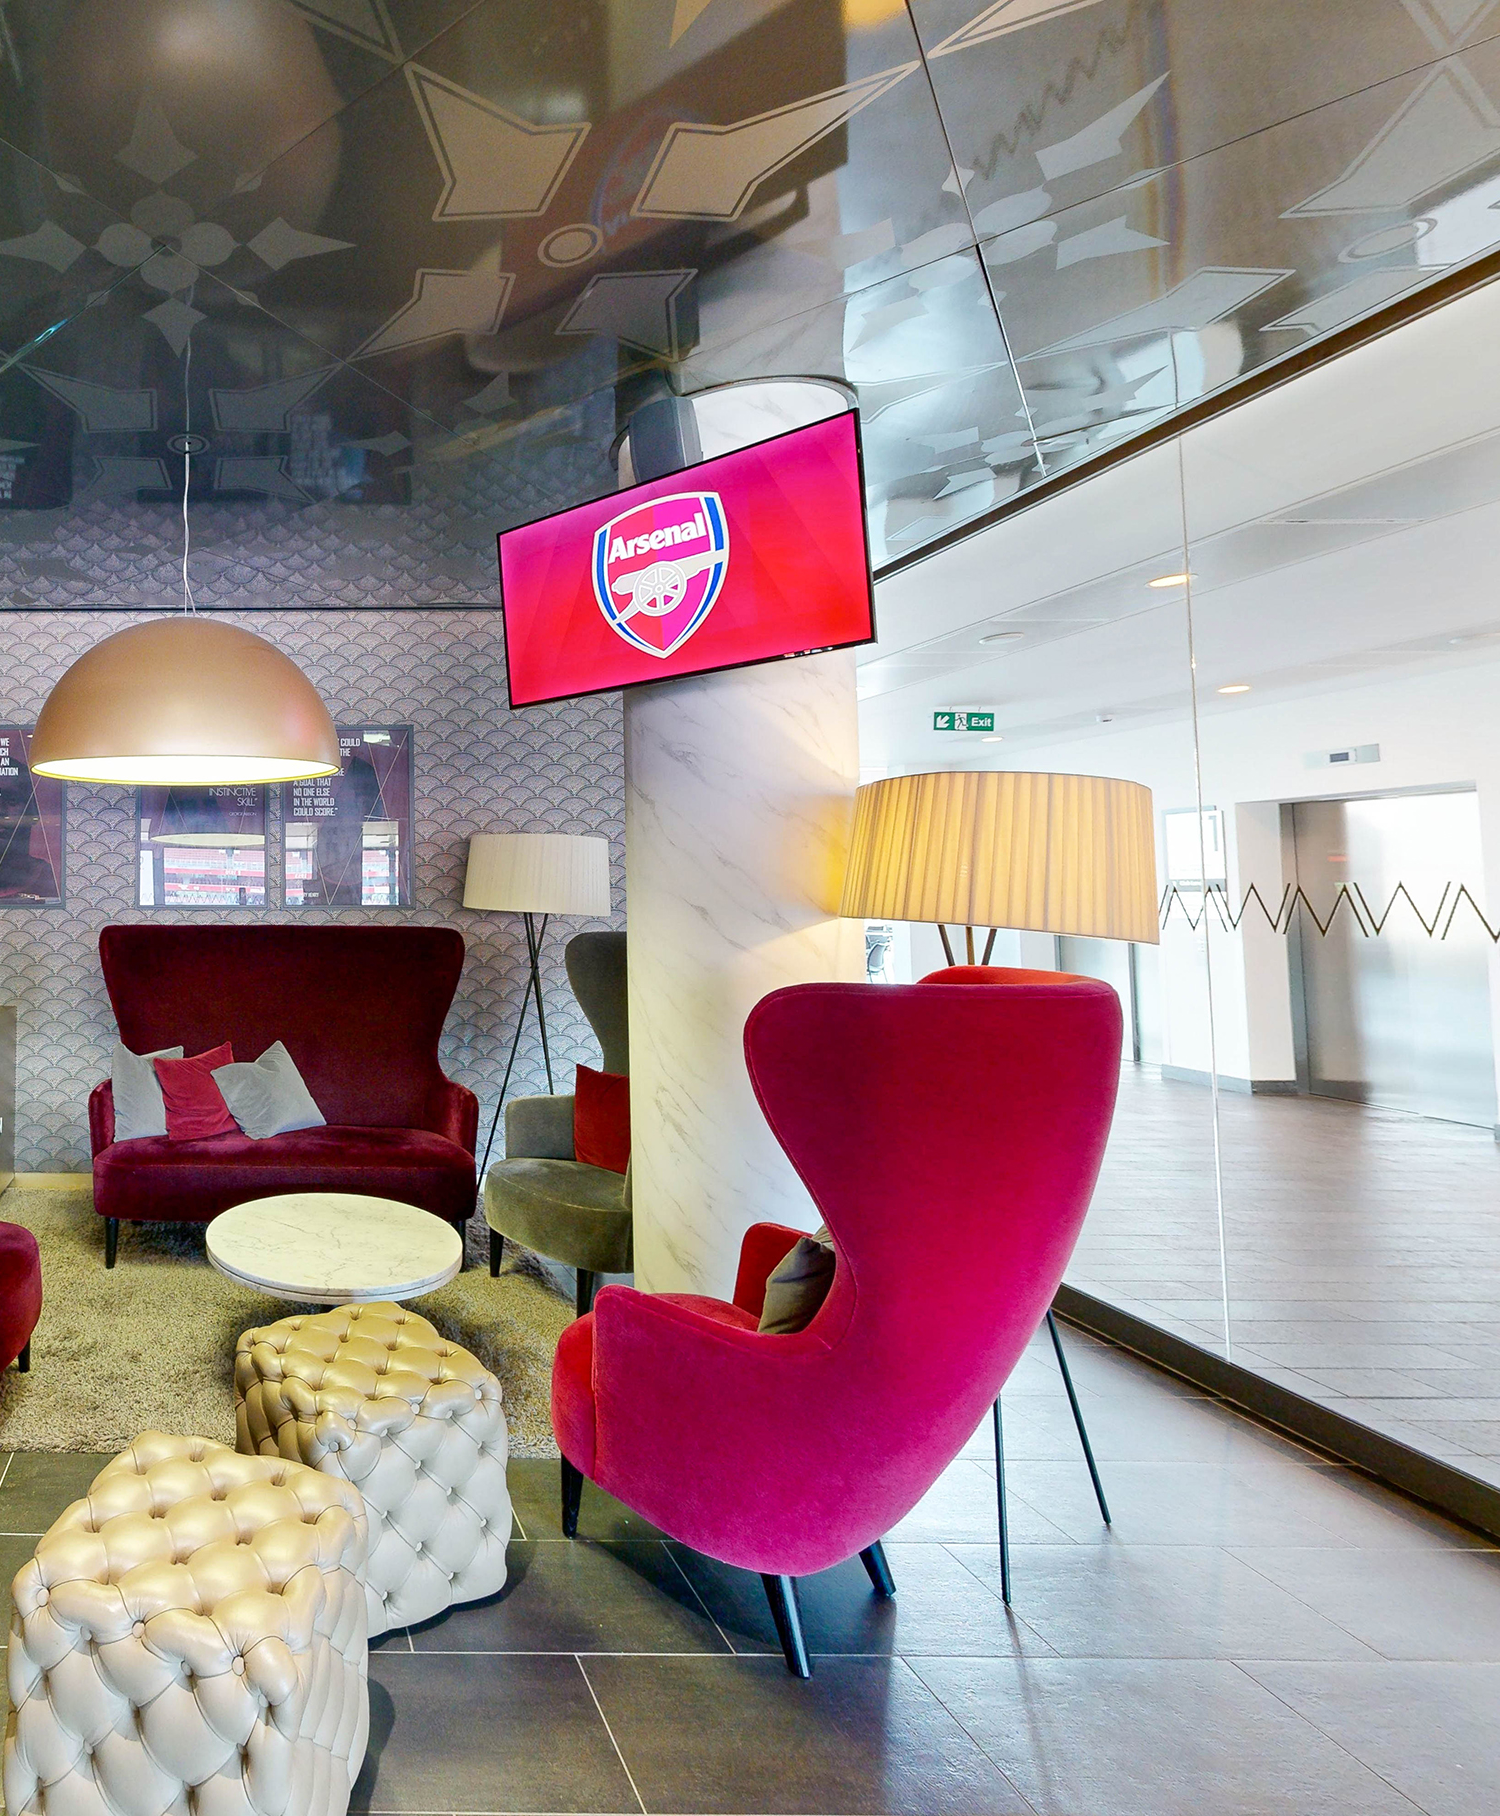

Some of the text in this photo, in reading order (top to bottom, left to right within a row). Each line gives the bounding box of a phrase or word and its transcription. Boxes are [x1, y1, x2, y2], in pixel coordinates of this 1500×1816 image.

[608, 512, 707, 564] Arsenal
[971, 717, 992, 727] Exit
[0, 737, 10, 747] WE
[340, 738, 361, 747] COULD
[340, 747, 351, 757] THE
[0, 757, 10, 766] AN
[299, 778, 316, 787] GOAL
[316, 778, 332, 787] THAT
[208, 787, 257, 797] INSTINCTIVE
[293, 787, 331, 797] NO ONE ELSE
[293, 797, 335, 806] IN THE WORLD
[293, 807, 314, 817] COULD
